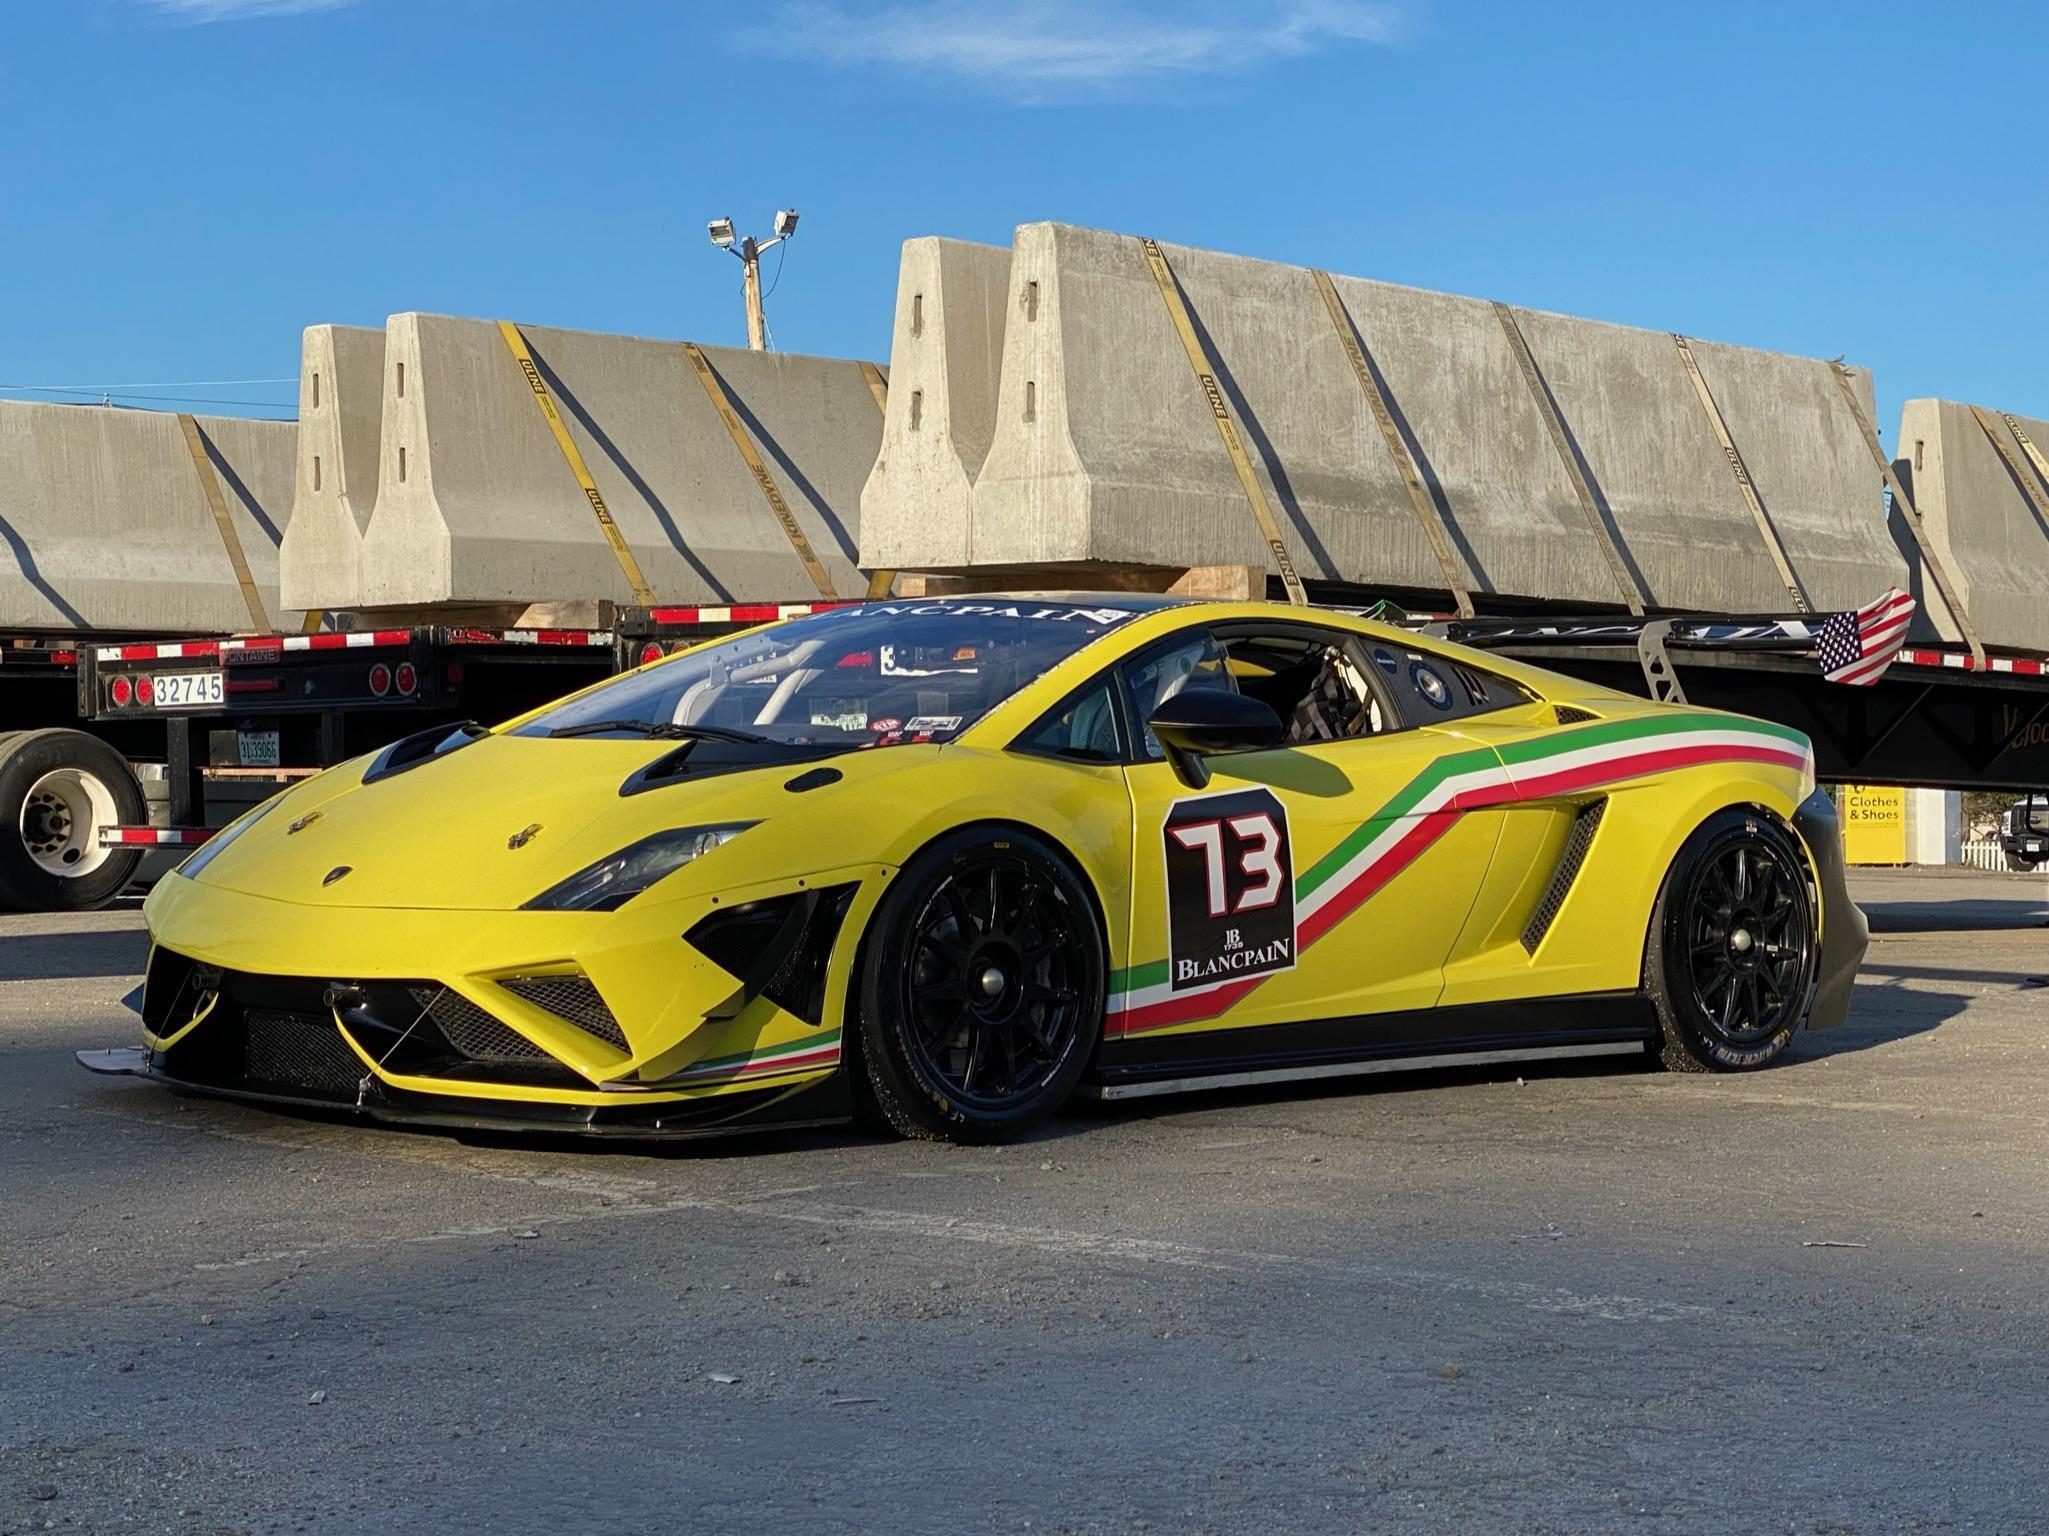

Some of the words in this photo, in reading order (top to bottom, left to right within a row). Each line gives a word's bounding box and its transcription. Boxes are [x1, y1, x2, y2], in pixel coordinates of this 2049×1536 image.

[521, 360, 545, 393] ULINE
[1343, 335, 1394, 427] KINEDYNE
[1202, 377, 1226, 418] ULINE
[1727, 448, 1747, 485] ULINE
[587, 489, 611, 524] ULINE
[752, 463, 801, 539] KINEDYNE
[1271, 541, 1298, 586] ULINE
[223, 649, 275, 663] FONTAINE
[156, 675, 222, 703] 32745
[1850, 796, 1899, 807] Clothes
[1850, 809, 1859, 820] &
[1861, 809, 1899, 820] Shoes
[1167, 811, 1284, 918] 73
